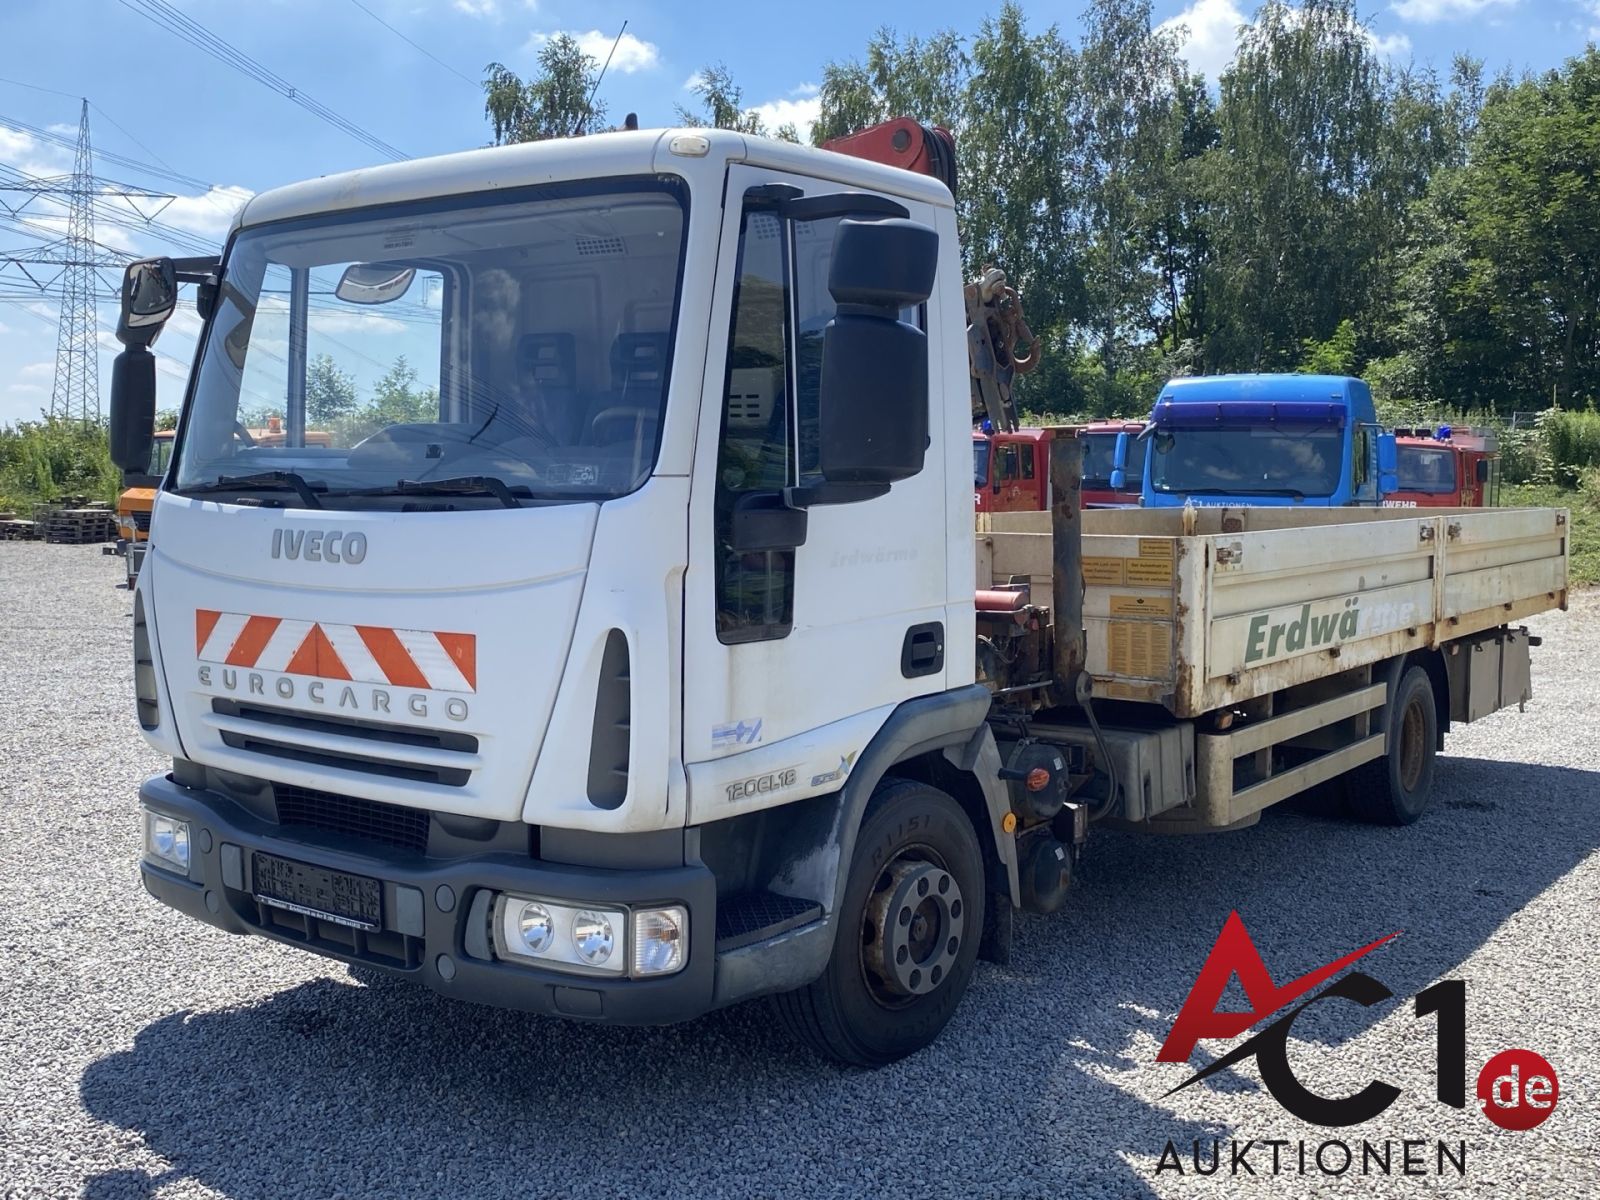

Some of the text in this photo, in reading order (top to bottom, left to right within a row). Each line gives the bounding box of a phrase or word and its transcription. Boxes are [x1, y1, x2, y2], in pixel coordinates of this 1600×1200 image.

[270, 528, 368, 565] IVECO
[197, 665, 470, 722] EUROCARGO
[725, 769, 797, 802] 120EL18
